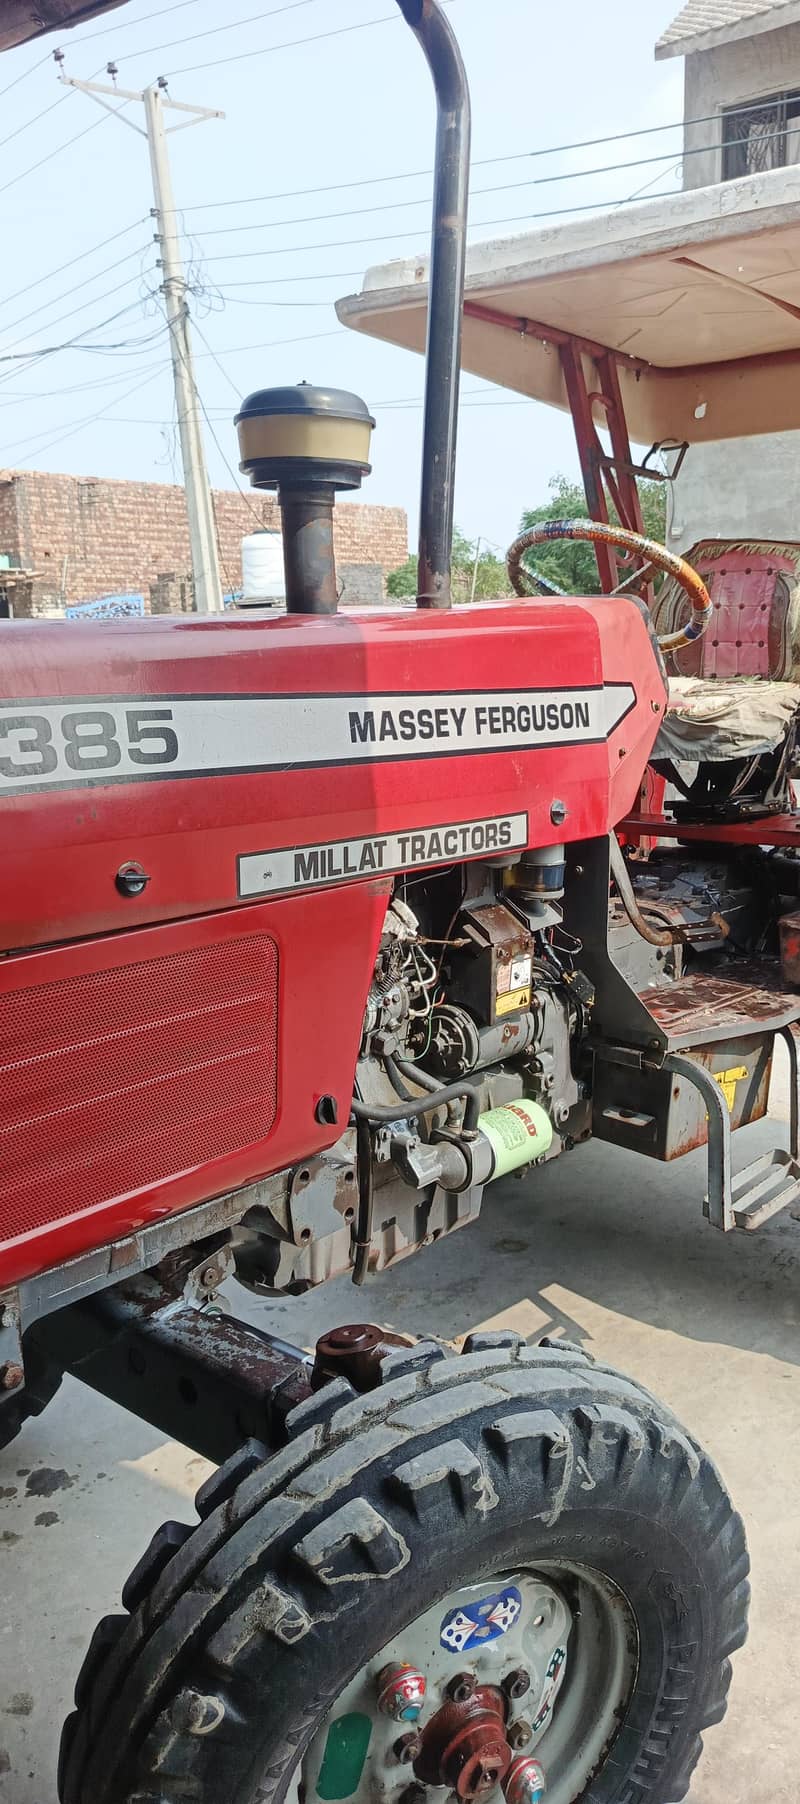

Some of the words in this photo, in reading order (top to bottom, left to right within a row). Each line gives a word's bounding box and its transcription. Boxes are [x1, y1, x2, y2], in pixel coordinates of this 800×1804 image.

[0, 709, 178, 777] 385
[348, 707, 467, 743] MASSEY
[475, 702, 590, 735] FERGUSON
[293, 839, 388, 882] MILLAT
[397, 821, 512, 864] TRACTORS
